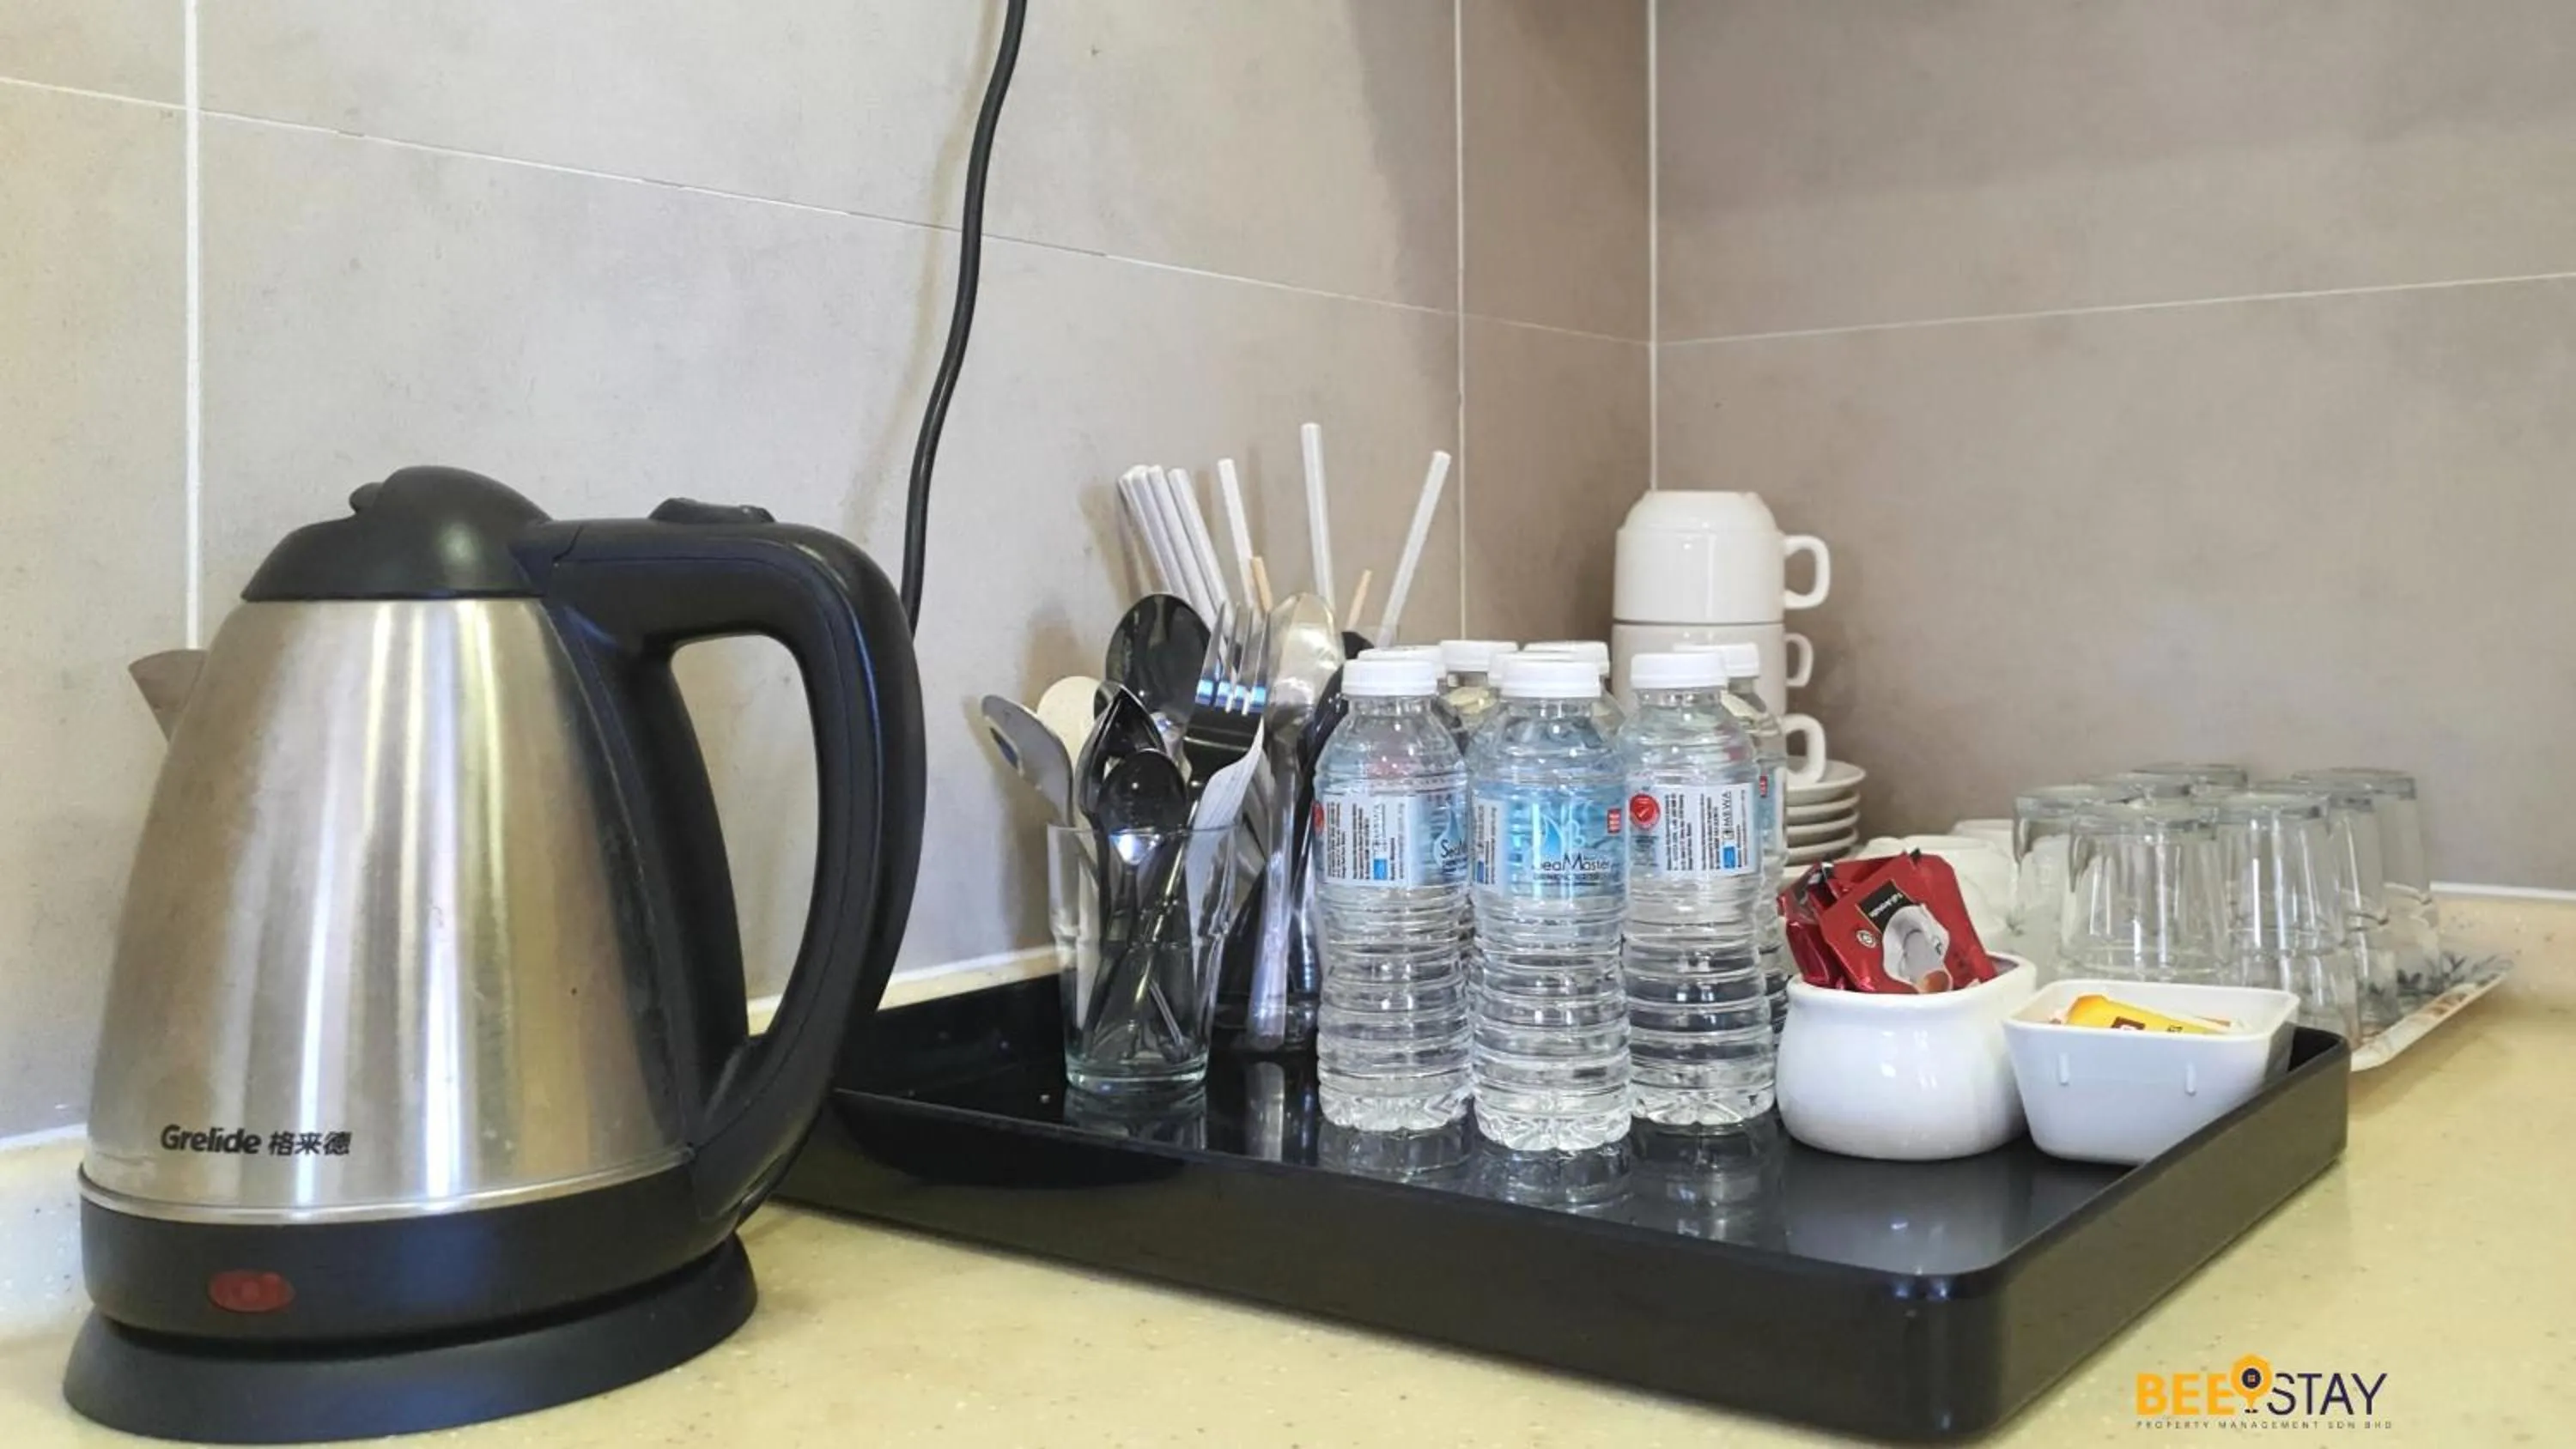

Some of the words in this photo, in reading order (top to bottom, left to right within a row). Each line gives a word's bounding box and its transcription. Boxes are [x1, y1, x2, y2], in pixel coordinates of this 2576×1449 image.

[161, 1125, 261, 1154] Grelide
[268, 1131, 352, 1155] 格来德
